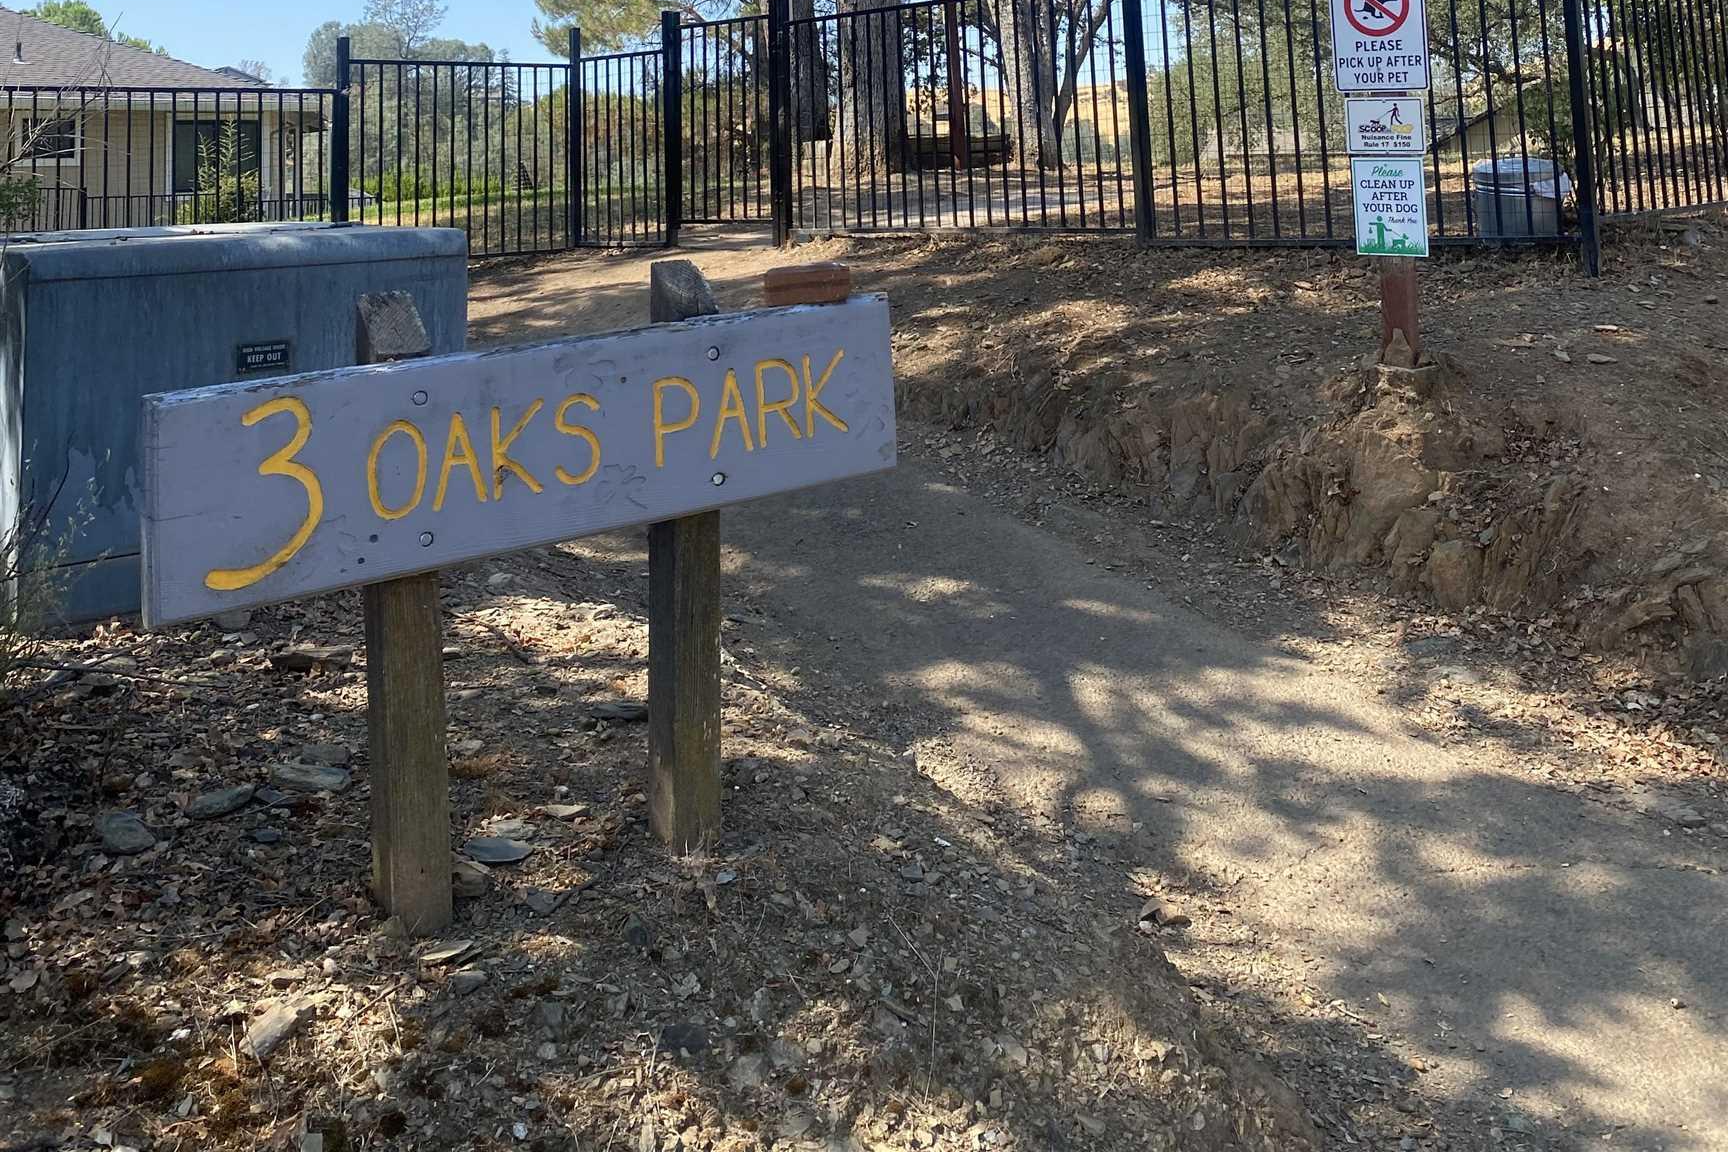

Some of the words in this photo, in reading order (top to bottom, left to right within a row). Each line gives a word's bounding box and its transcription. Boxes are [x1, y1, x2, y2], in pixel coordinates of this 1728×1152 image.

[1355, 39, 1403, 52] PLEASE
[1339, 56, 1364, 68] PICK
[1368, 56, 1382, 67] UP
[1386, 55, 1422, 67] AFTER
[1354, 71, 1384, 84] YOUR
[1388, 71, 1408, 83] PET
[1359, 124, 1386, 133] SCOOP
[1371, 165, 1404, 177] Please
[1360, 179, 1396, 189] CLEAN
[1399, 180, 1415, 189] UP
[1371, 192, 1408, 201] AFTER
[1363, 203, 1393, 213] YOUR
[1395, 203, 1418, 213] DOG
[1388, 216, 1405, 224] Thank
[247, 354, 264, 363] KEEP
[266, 352, 281, 360] OUT
[205, 396, 324, 591] 3
[367, 393, 600, 520] OAKS
[654, 347, 849, 469] PARK
